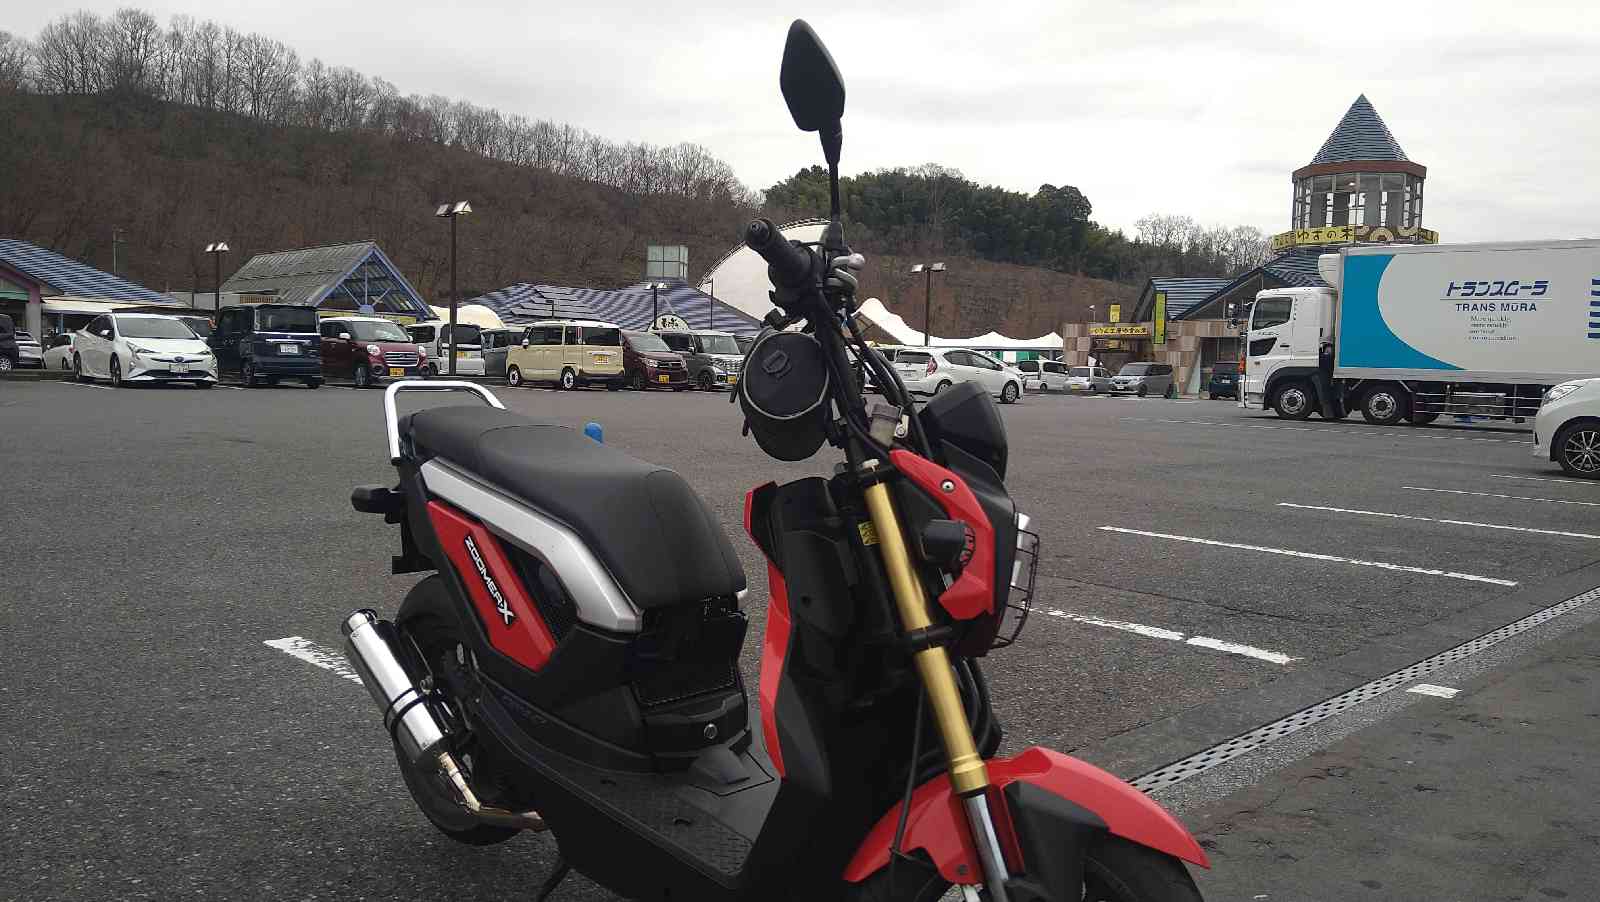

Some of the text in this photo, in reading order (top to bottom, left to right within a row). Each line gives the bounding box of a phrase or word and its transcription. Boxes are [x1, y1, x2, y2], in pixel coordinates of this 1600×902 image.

[1446, 280, 1549, 297] トランスムーラ
[1456, 303, 1496, 312] TRANS
